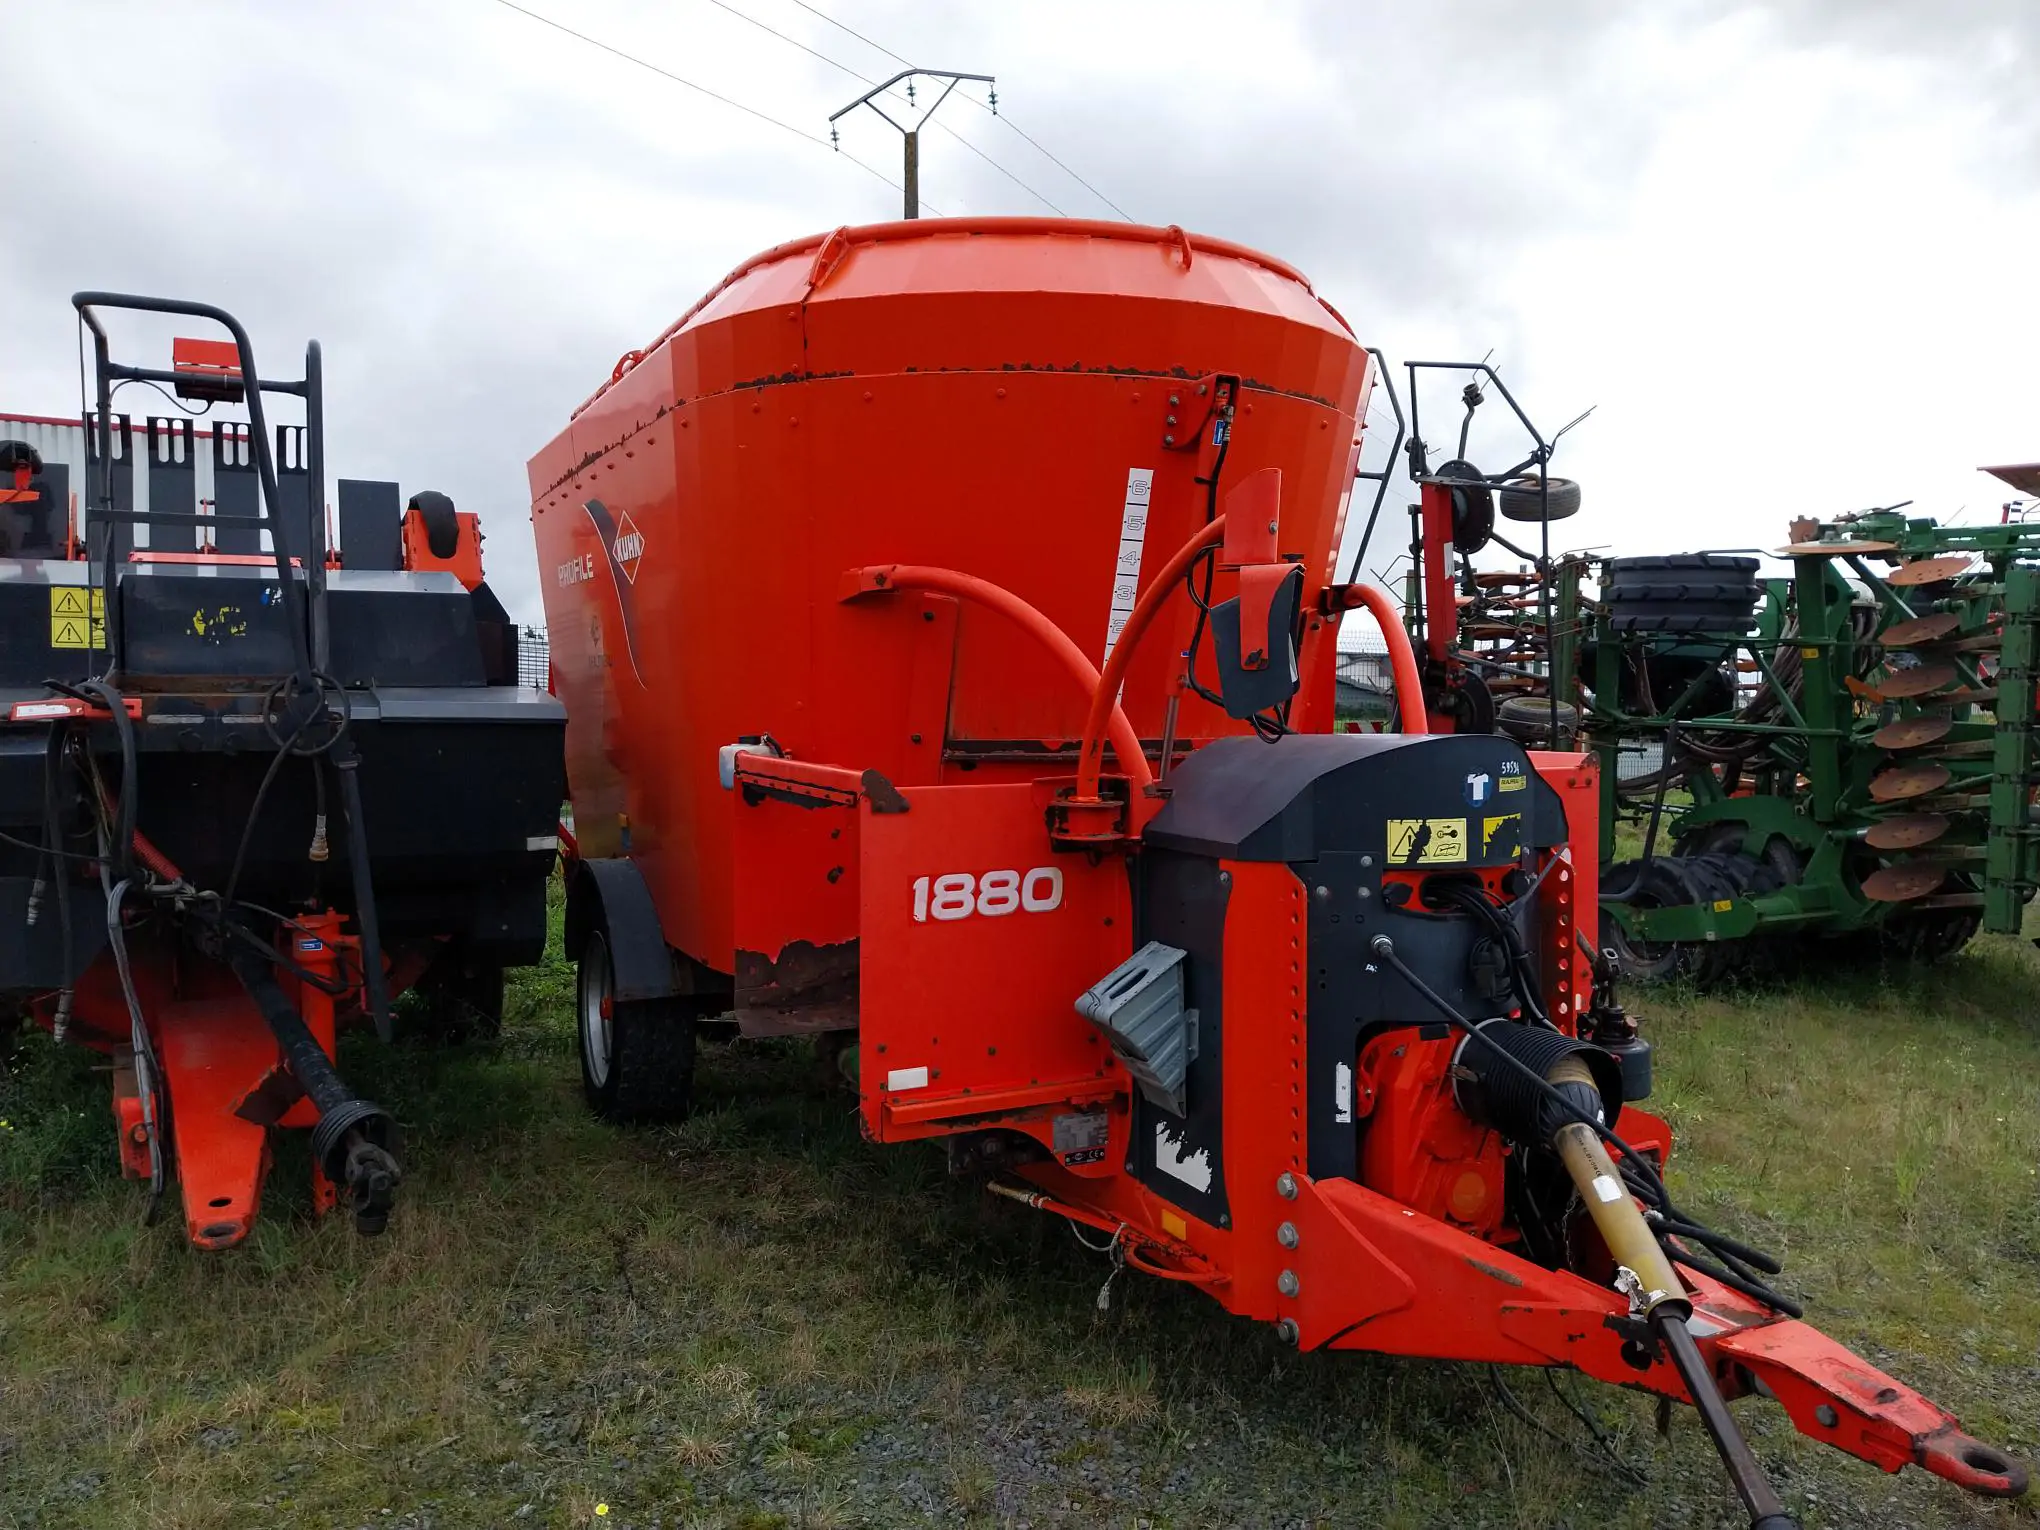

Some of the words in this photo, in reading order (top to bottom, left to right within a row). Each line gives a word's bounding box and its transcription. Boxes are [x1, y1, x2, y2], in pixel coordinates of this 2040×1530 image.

[616, 532, 642, 563] KUHN
[558, 553, 594, 587] PROFILE
[912, 866, 1064, 923] 1880
